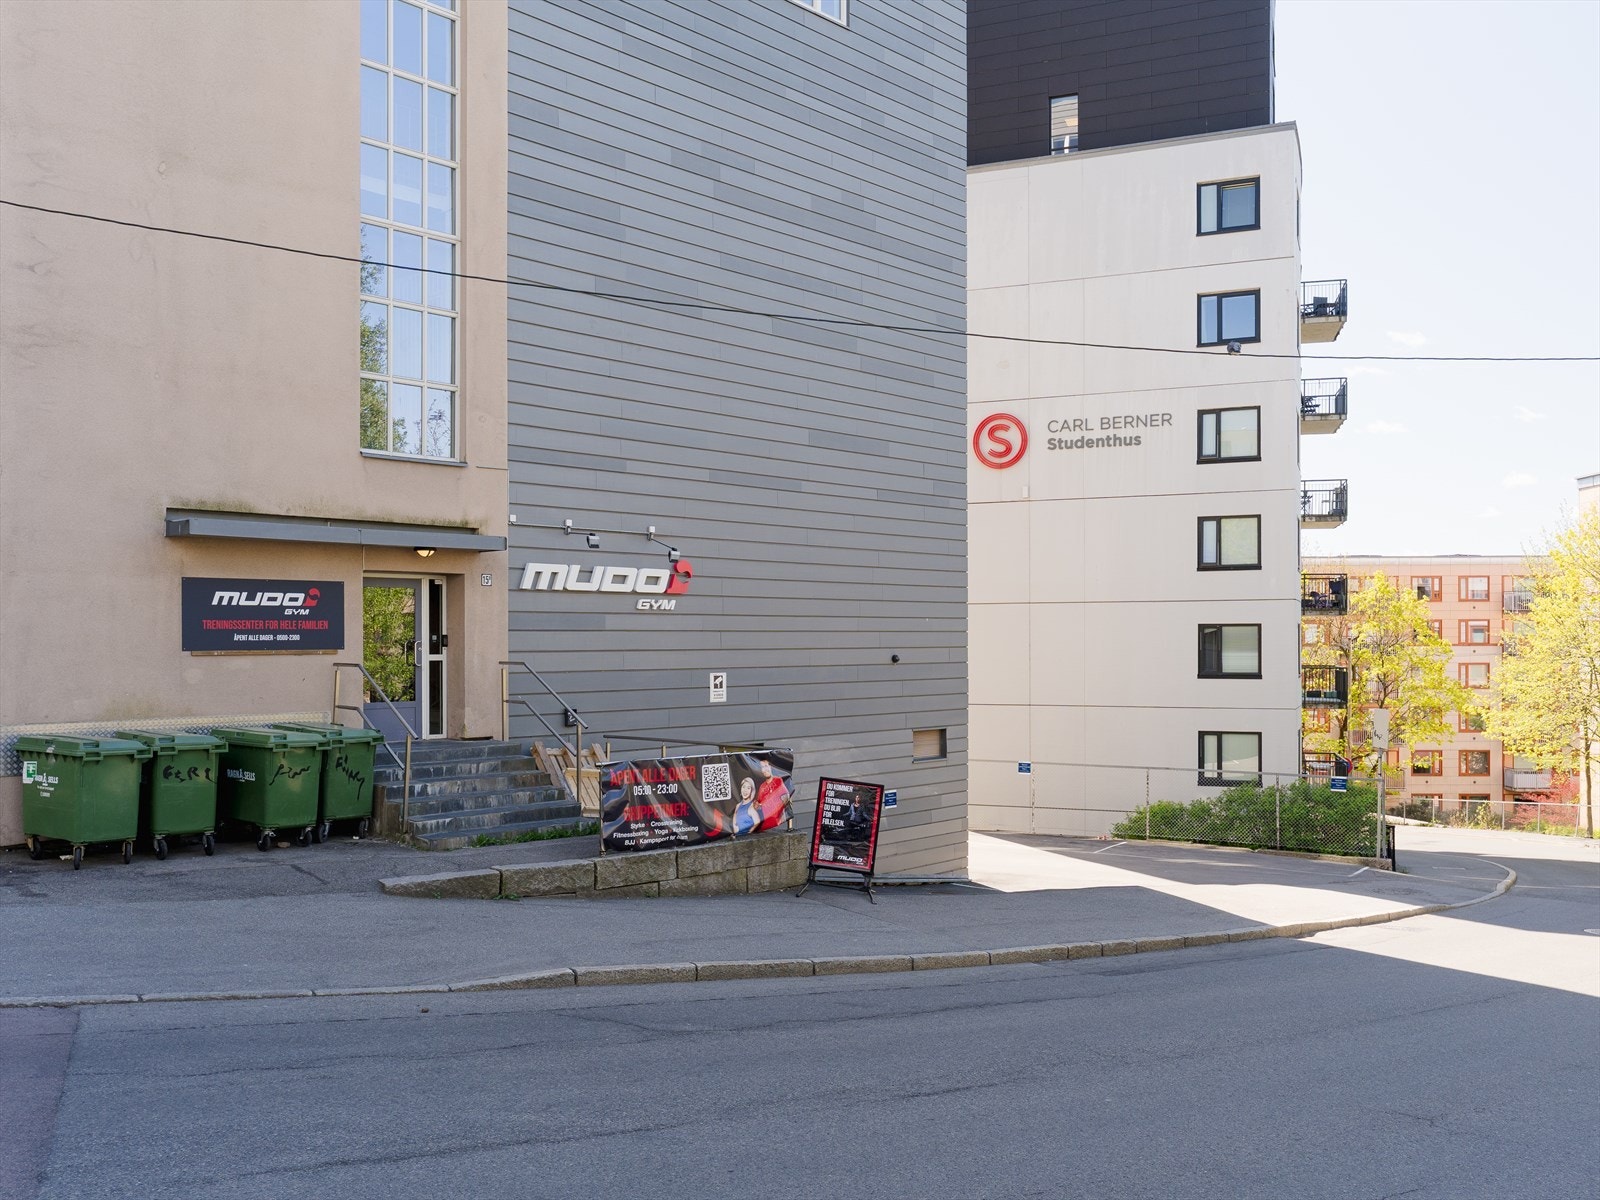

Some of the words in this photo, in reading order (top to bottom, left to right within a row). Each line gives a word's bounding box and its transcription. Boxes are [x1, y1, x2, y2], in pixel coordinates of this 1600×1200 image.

[1047, 418, 1094, 433] CARL
[1101, 412, 1173, 430] BERNER
[1047, 434, 1142, 451] Studenthus
[519, 562, 671, 594] MUDO
[211, 591, 306, 607] MUDO
[636, 599, 677, 611] GYM
[284, 608, 310, 616] GYM
[202, 619, 264, 631] TRENINGSSENTER
[265, 620, 279, 630] FOR
[280, 620, 297, 630] HELE
[298, 620, 329, 630] FAMILIEN
[233, 633, 248, 641] ÅPENT
[642, 767, 667, 783] ALLE
[668, 765, 696, 782] DAGER
[633, 784, 652, 796] 05:00
[657, 783, 678, 794] 23:00
[613, 829, 649, 838] Fitnessboxing
[654, 828, 669, 836] Yoga
[640, 836, 670, 845] Kampsport
